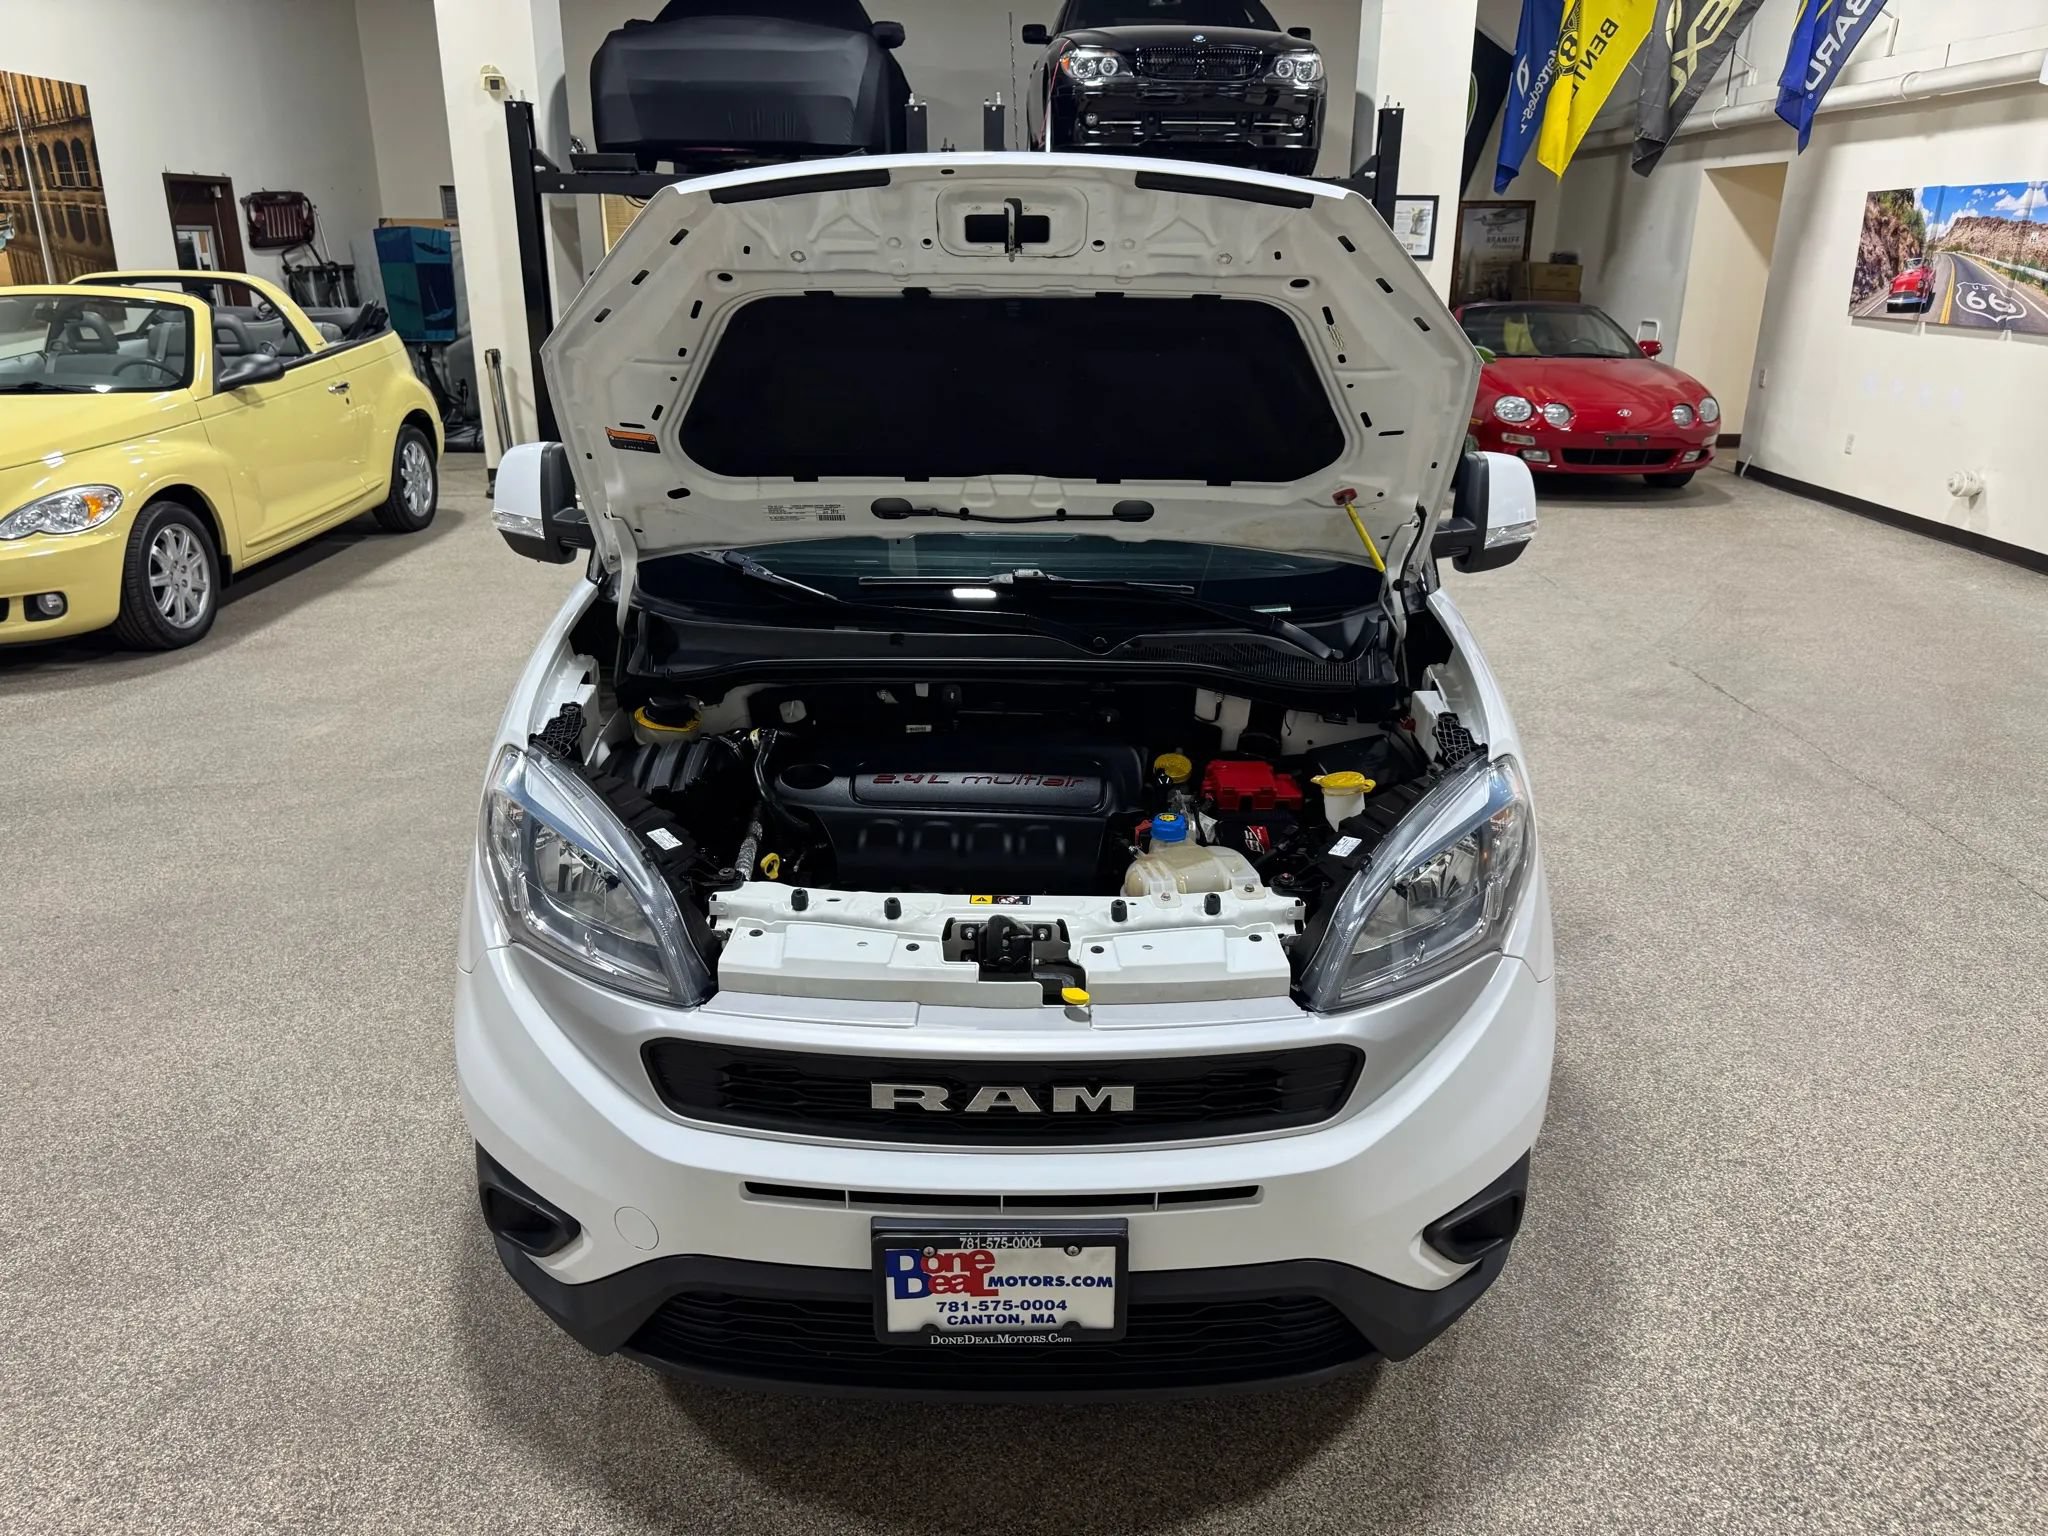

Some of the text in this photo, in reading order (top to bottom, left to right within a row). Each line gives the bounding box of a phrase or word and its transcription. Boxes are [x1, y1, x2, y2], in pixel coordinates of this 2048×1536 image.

[1966, 291, 2017, 314] 66
[960, 773, 1086, 788] multiair
[871, 1083, 1134, 1113] RAM
[960, 1236, 1042, 1250] 781-575-0004
[886, 1249, 996, 1277] Done
[987, 1275, 1113, 1288] MOTORS.COM
[936, 1300, 1068, 1313] 781-575-0004
[946, 1313, 1057, 1326] CANTON, MA
